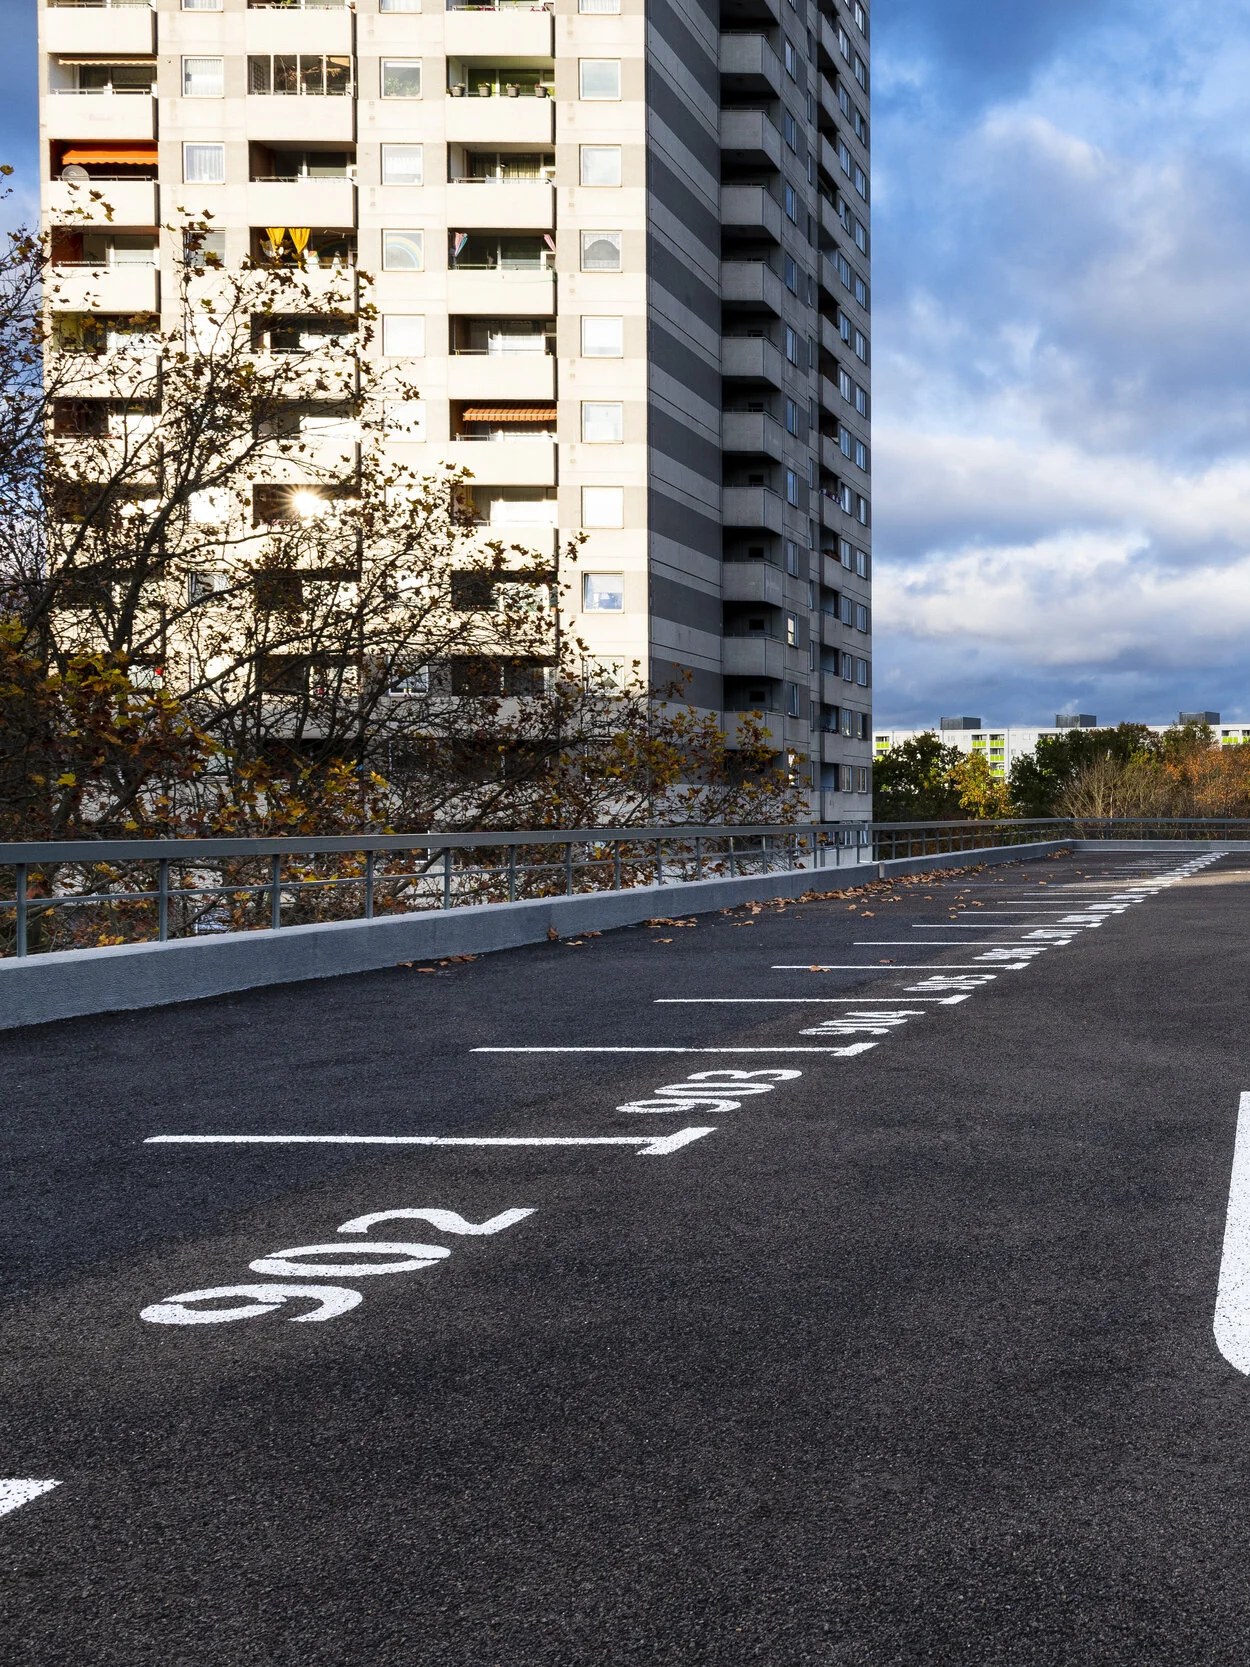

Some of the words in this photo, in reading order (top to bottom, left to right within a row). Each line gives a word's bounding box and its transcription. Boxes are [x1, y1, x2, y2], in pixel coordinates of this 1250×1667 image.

[903, 974, 998, 992] 905
[798, 1010, 926, 1035] 904
[615, 1069, 803, 1113] 903
[139, 1208, 539, 1325] 902
